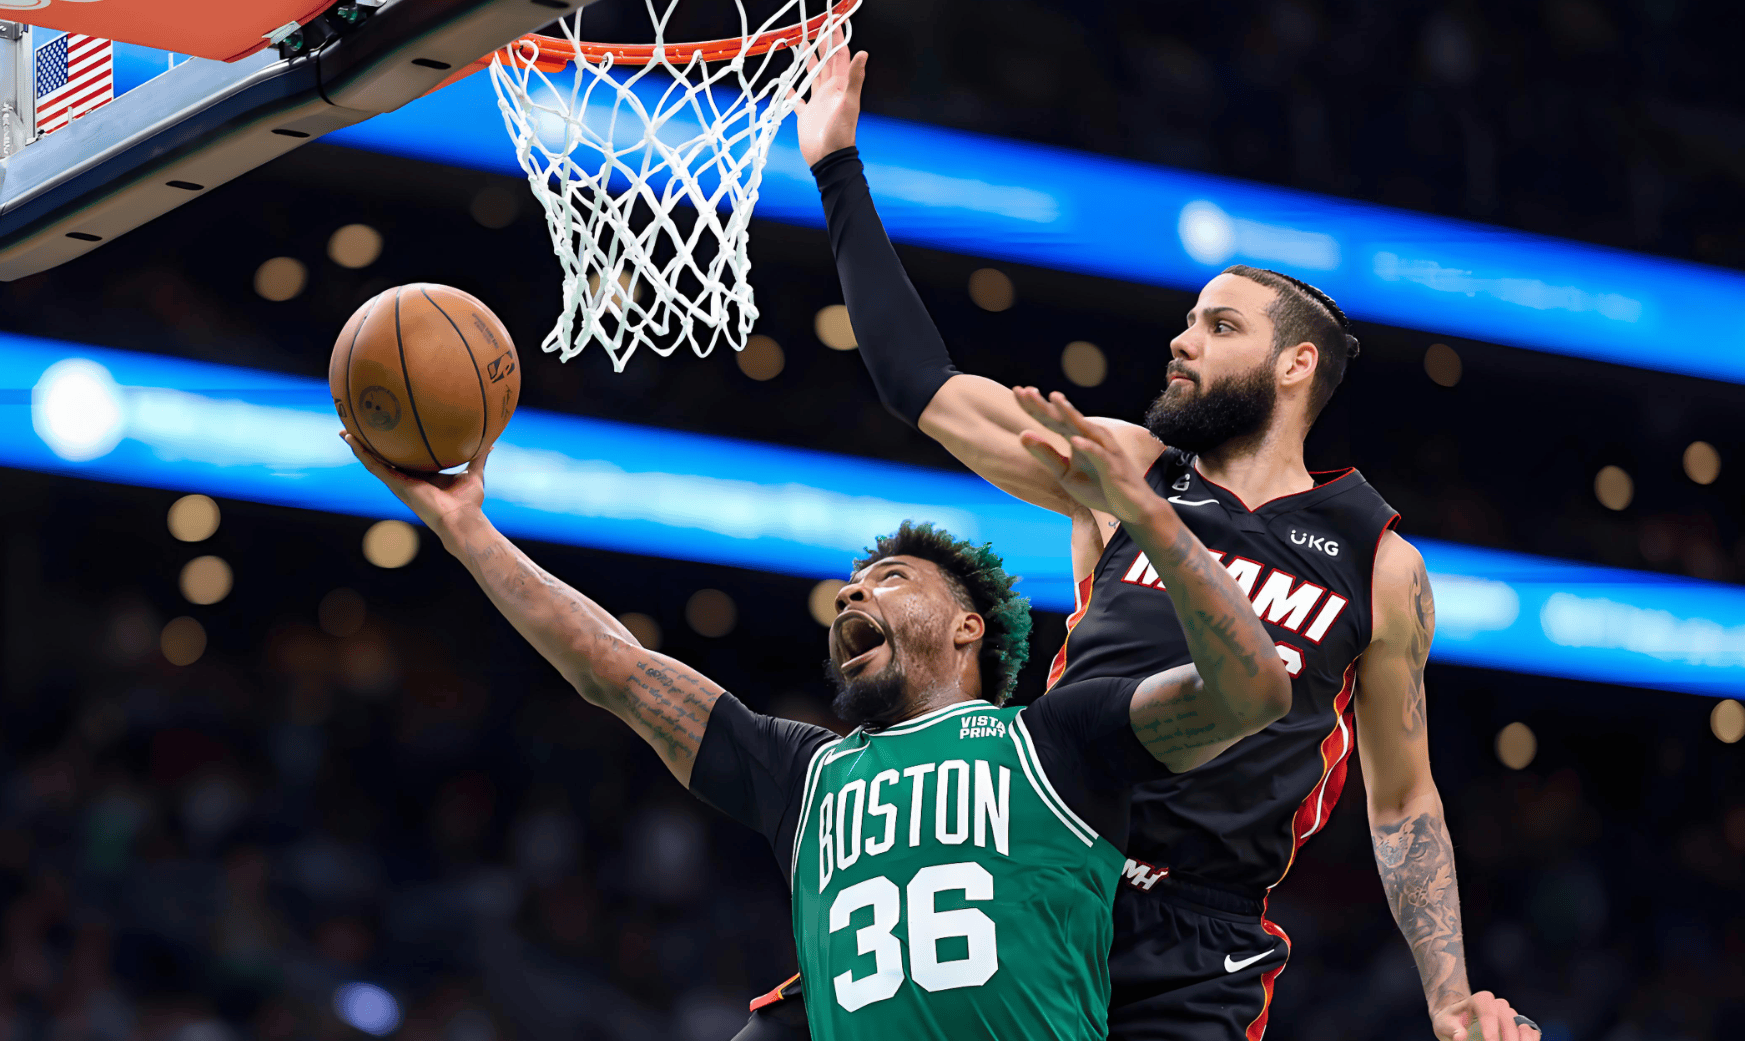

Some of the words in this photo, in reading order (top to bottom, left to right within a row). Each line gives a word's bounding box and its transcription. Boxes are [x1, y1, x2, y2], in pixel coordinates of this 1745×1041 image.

[1120, 548, 1349, 646] MAMI
[959, 726, 1004, 740] PRINT
[960, 715, 1006, 735] VISTA
[818, 759, 1011, 895] BOSTON
[829, 861, 999, 1013] 36
